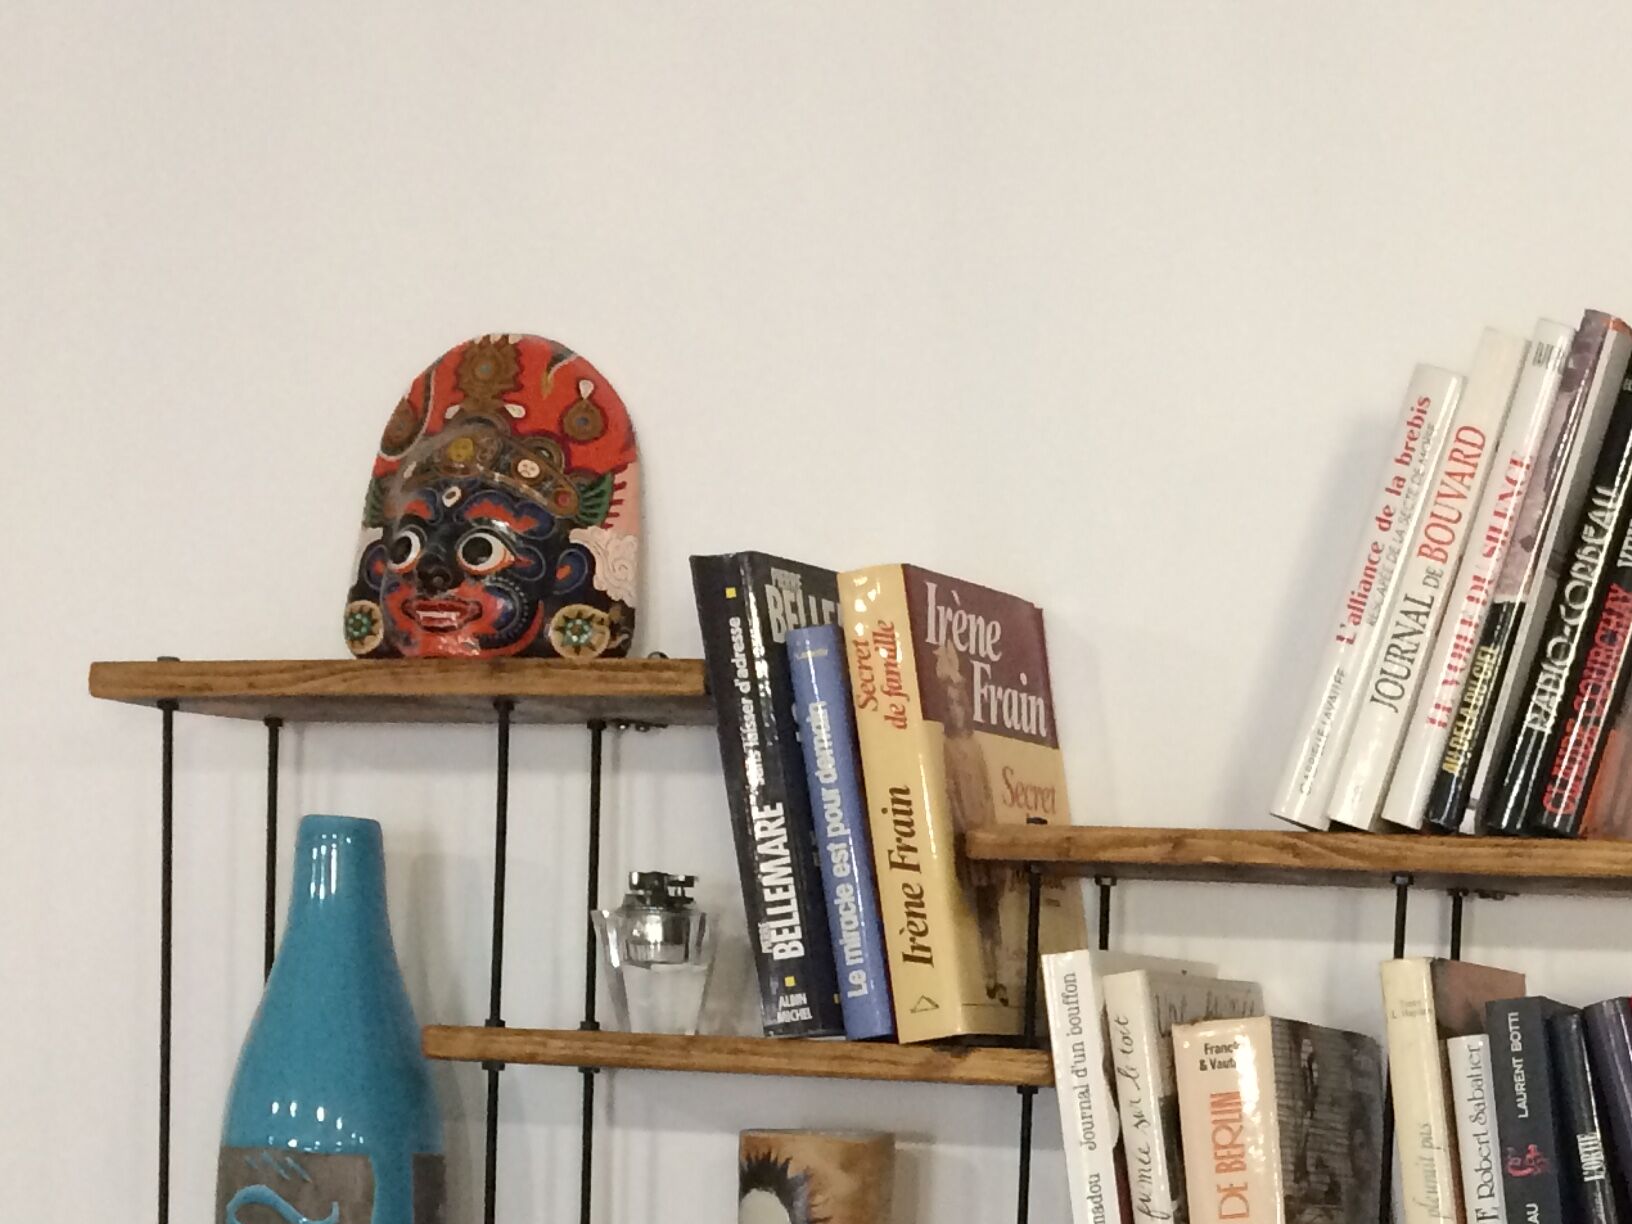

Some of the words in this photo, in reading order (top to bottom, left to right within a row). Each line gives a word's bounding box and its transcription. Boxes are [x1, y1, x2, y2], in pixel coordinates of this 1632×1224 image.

[1394, 396, 1431, 467] brebis
[1375, 504, 1395, 532] de
[1384, 474, 1407, 497] la
[1416, 425, 1486, 565] BOUVARD
[1335, 541, 1384, 645] L'alliance
[1421, 565, 1444, 589] DE
[1427, 702, 1453, 730] LE
[1441, 613, 1484, 691] VOILE
[1466, 574, 1494, 608] DU
[1482, 455, 1536, 563] SILENCE
[728, 616, 751, 694] d'adresse
[924, 581, 1002, 662] Irène
[1369, 593, 1435, 713] JOURNAL
[851, 639, 879, 712] Secret
[871, 619, 909, 703] famille
[883, 703, 908, 730] de
[971, 659, 1048, 738] Frain
[810, 699, 838, 784] demain
[1542, 718, 1601, 816] CLAUDE
[821, 787, 850, 836] pour
[1002, 765, 1056, 815] Secret
[826, 842, 851, 878] est
[880, 787, 922, 874] Frain
[750, 802, 805, 961] BELLEMARE
[833, 882, 864, 965] miracle
[898, 882, 934, 967] Irène
[847, 969, 868, 997] Le
[1060, 972, 1083, 1036] bouffon
[1070, 1041, 1088, 1078] d'un
[1113, 1016, 1134, 1055] toit
[1200, 1060, 1207, 1071] &
[1507, 1011, 1523, 1052] BOTTI
[1116, 1064, 1141, 1091] le
[1465, 1044, 1488, 1126] Sabatier
[1511, 1056, 1529, 1118] LAURENT
[1072, 1083, 1097, 1151] Journal
[1128, 1098, 1149, 1133] sur
[1209, 1091, 1247, 1174] BERLIN
[1418, 1122, 1443, 1151] pas
[1472, 1129, 1496, 1199] Robert
[1216, 1182, 1250, 1220] DE
